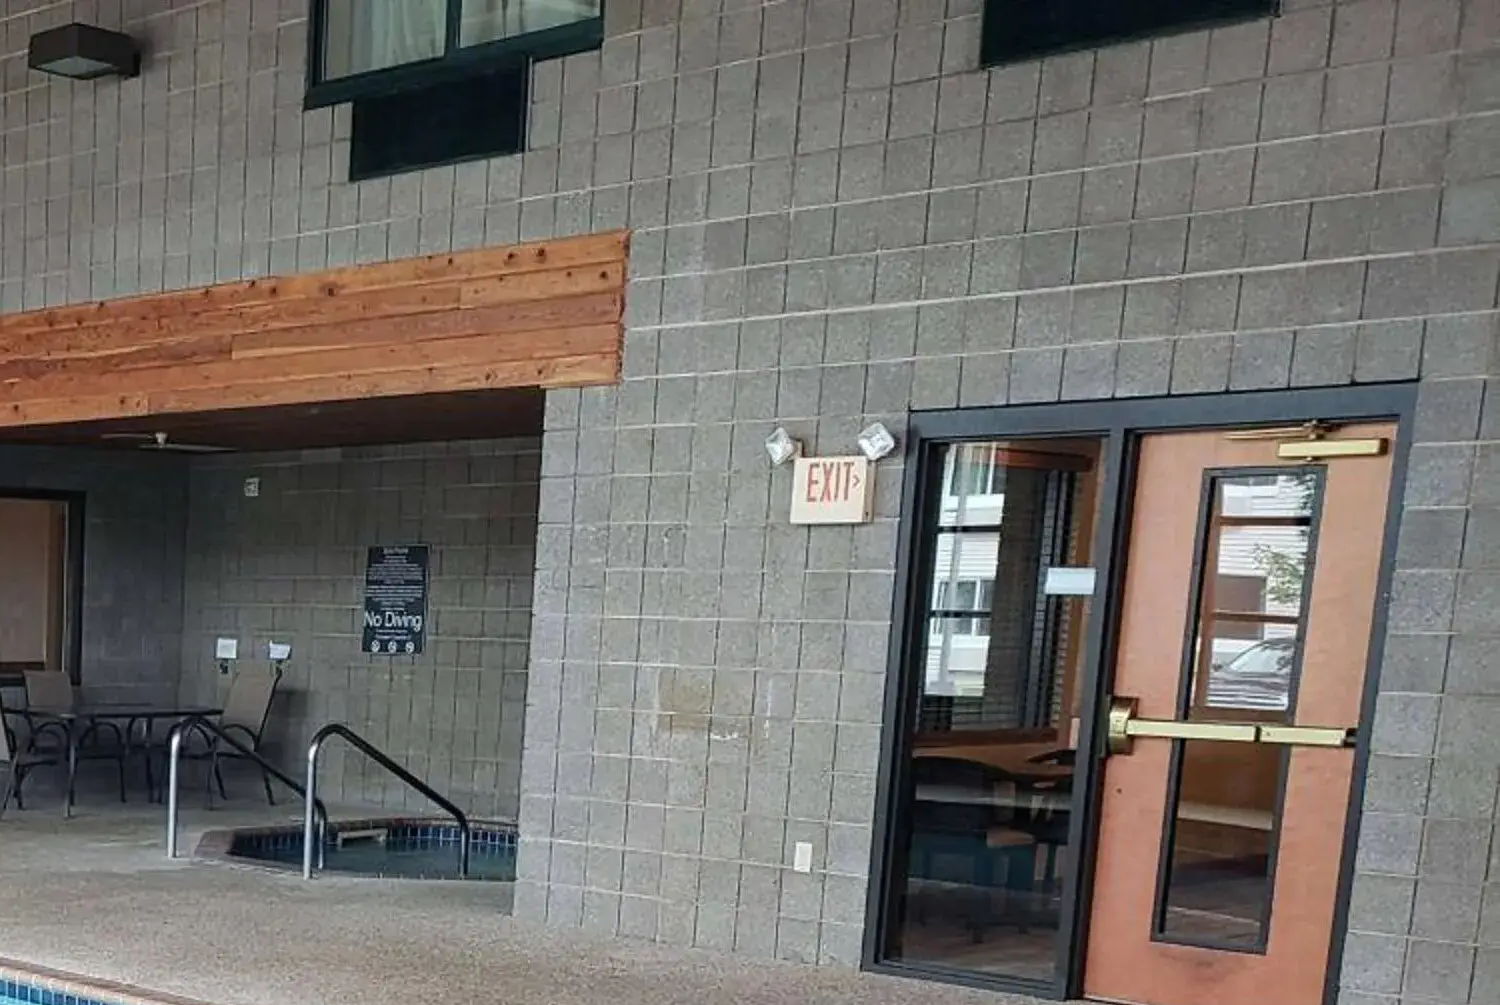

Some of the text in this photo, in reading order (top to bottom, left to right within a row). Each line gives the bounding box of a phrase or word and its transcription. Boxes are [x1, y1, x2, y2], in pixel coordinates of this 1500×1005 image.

[806, 461, 855, 503] EXIT
[364, 610, 422, 632] No Diving
